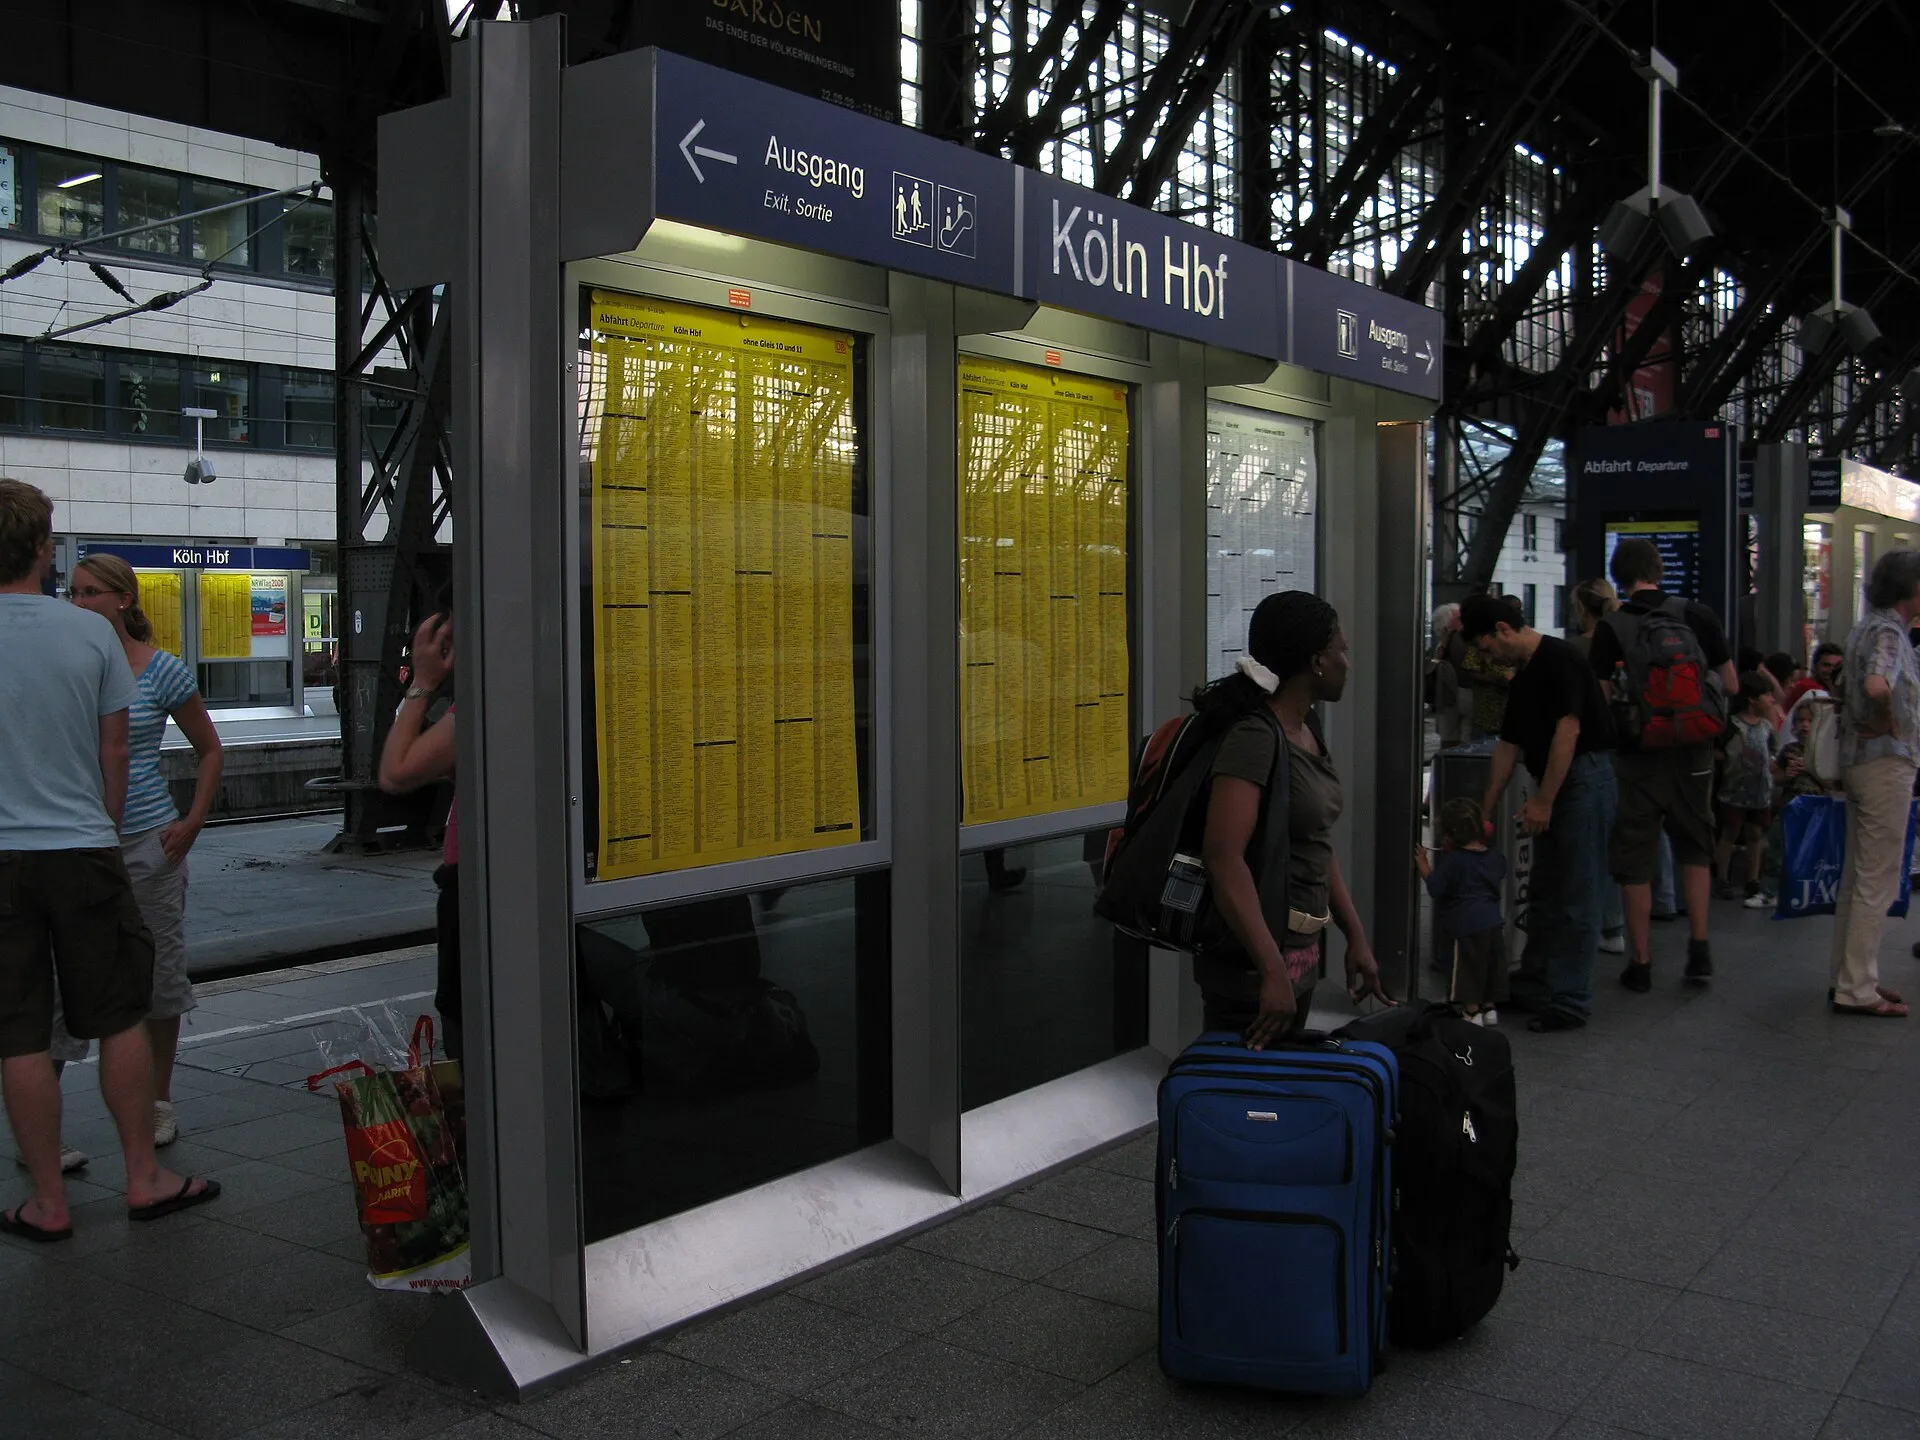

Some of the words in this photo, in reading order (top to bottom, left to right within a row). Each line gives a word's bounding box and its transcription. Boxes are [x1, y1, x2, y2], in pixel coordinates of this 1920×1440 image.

[705, 16, 725, 32] DAS
[725, 23, 749, 42] ENDE
[750, 33, 769, 48] DER
[769, 39, 857, 79] VÖLKERWANDERUNG
[764, 135, 865, 199] Ausgang
[763, 189, 791, 215] Exit,
[795, 197, 834, 223] Sortie
[1052, 198, 1148, 299] Köln
[1164, 235, 1228, 320] Hbf
[599, 313, 629, 327] Abfahrt
[629, 317, 665, 332] Departure
[673, 326, 689, 336] Köln
[689, 328, 702, 338] Hbf
[743, 338, 759, 348] ohne
[760, 340, 775, 349] Gleis
[776, 342, 784, 350] 10
[784, 344, 796, 352] und
[796, 345, 803, 353] 11
[1368, 320, 1408, 354] Ausgang
[1381, 356, 1393, 371] Exit,
[1393, 360, 1409, 374] Sortie
[1583, 459, 1633, 474] Abfahrt
[1636, 460, 1689, 473] Departure
[173, 548, 202, 564] Köln
[206, 549, 230, 564] Hbf
